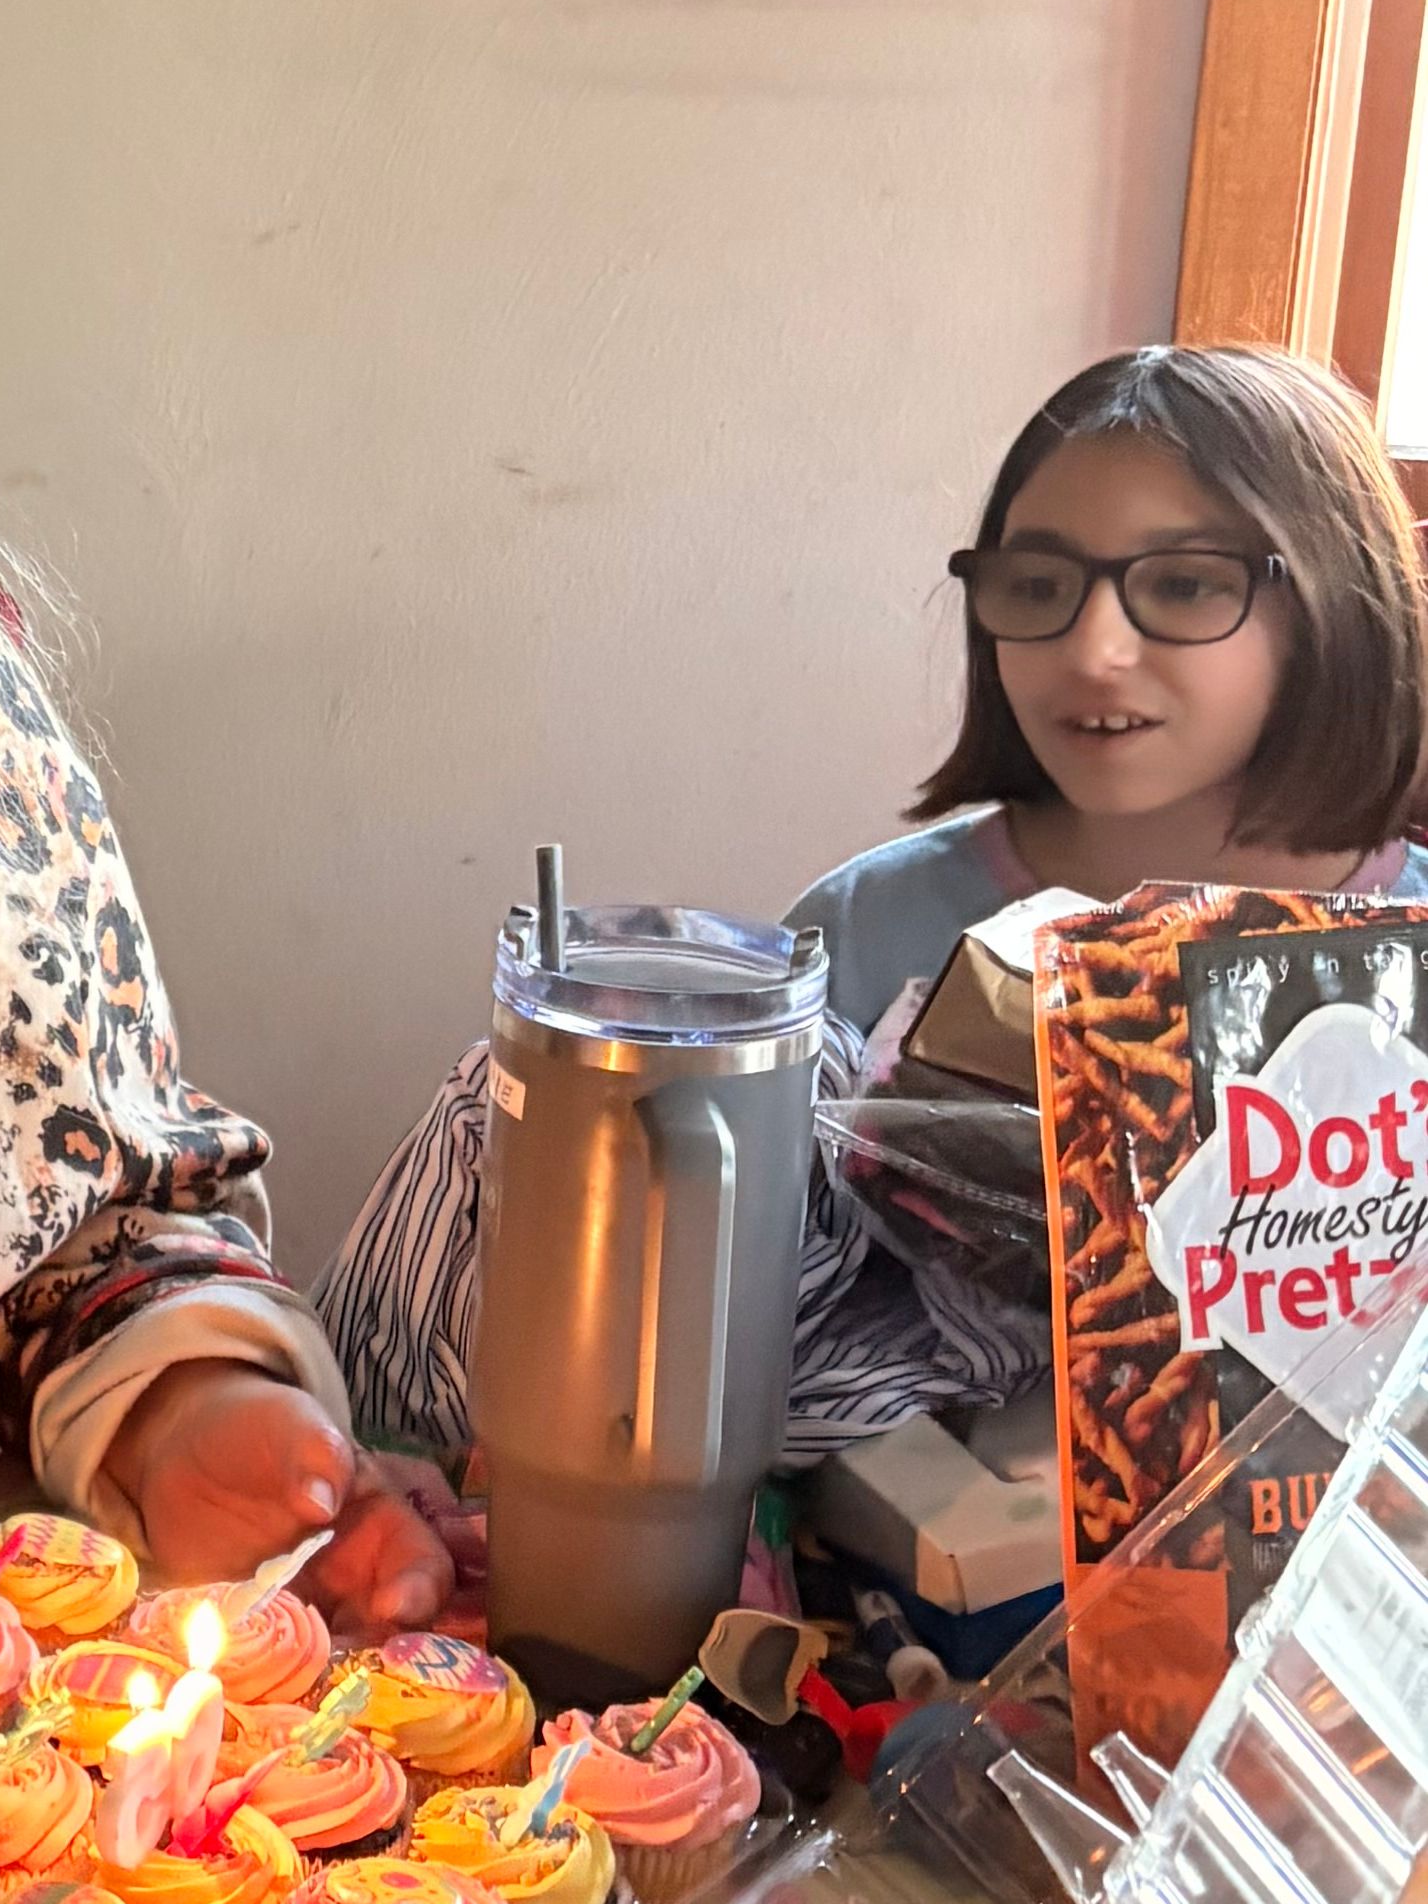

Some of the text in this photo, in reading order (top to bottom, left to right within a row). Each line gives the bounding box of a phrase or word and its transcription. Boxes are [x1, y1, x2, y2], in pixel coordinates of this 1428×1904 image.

[1225, 1080, 1428, 1198] Dot'
[1219, 1176, 1428, 1265] Homesty
[1249, 1472, 1332, 1536] BU
